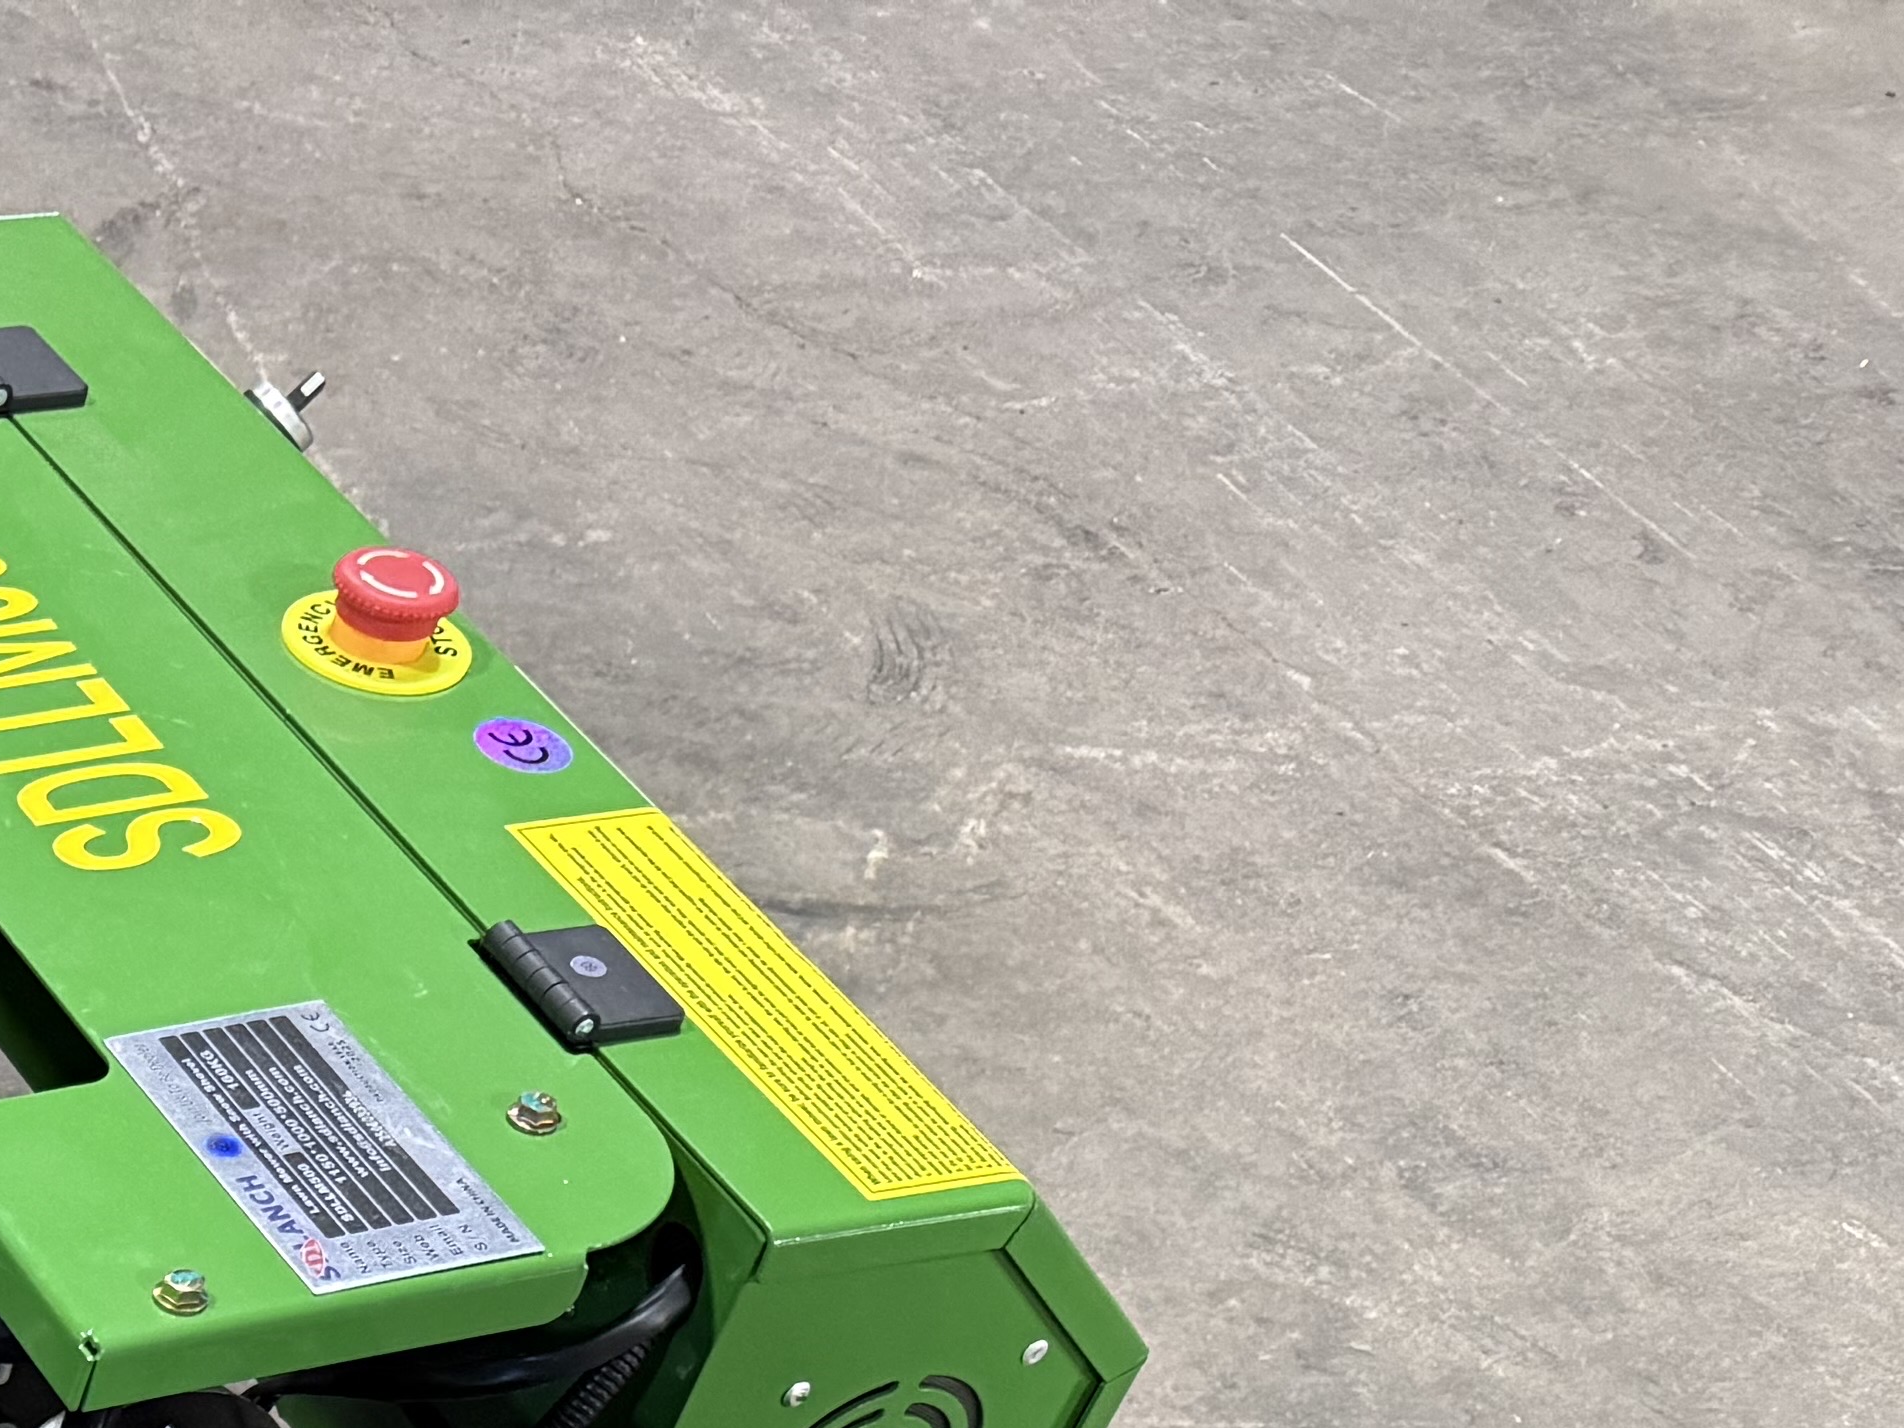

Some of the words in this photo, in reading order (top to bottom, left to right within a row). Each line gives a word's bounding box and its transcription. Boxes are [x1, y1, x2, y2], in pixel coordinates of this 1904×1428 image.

[179, 1057, 217, 1092] Shovel
[210, 1093, 243, 1122] Snow
[263, 1066, 371, 1178] www.sdlanch.com
[235, 1123, 264, 1146] with
[249, 1111, 293, 1150] Weight
[256, 1147, 295, 1183] Mower
[287, 1184, 321, 1214] Lawn
[453, 1177, 486, 1205] CHINA
[478, 1205, 497, 1216] IN
[427, 1222, 465, 1255] Email
[487, 1215, 520, 1243] MADE
[336, 1241, 372, 1273] Name
[361, 1239, 397, 1268] Type
[388, 1239, 418, 1264] Size
[409, 1233, 441, 1260] Web
